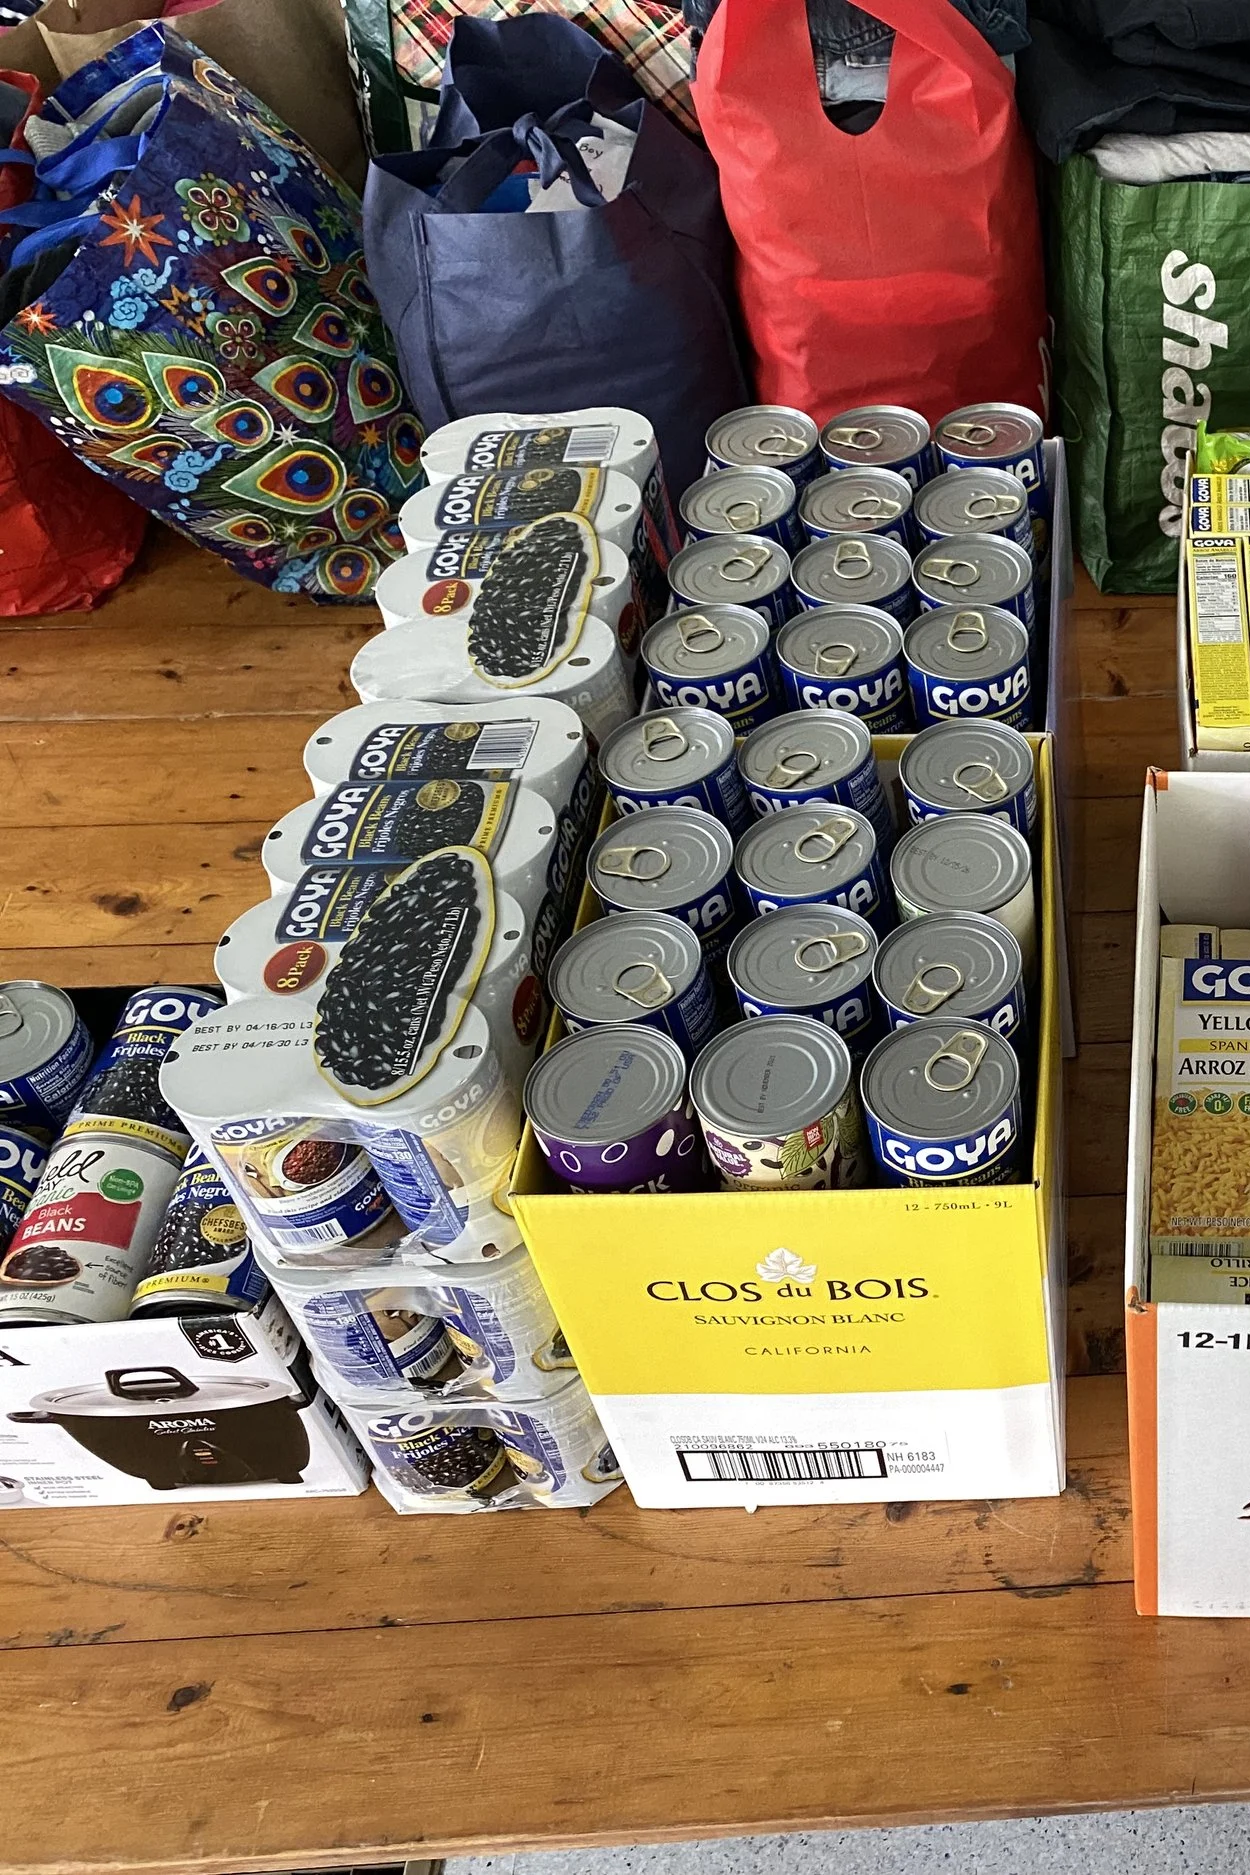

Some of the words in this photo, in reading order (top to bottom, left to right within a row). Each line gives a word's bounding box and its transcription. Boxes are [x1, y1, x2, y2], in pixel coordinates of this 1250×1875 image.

[579, 143, 603, 159] Boy
[443, 476, 484, 524] GOYA
[1194, 539, 1235, 547] GOYA
[433, 532, 469, 577] GOYA
[442, 582, 459, 605] Pack
[656, 671, 764, 708] GOYA
[802, 668, 902, 710] GOYA
[930, 665, 1030, 715] GOYA
[358, 727, 405, 779] GOYA
[312, 786, 370, 858] GOYA
[360, 820, 381, 848] Black
[373, 794, 392, 820] Beans
[372, 822, 395, 853] Frijoles
[286, 869, 340, 936] GOYA
[290, 946, 313, 977] Pack
[194, 1025, 220, 1034] BEST
[227, 1024, 240, 1032] BY
[245, 1022, 296, 1031] 04/16/30
[408, 1015, 422, 1036] cans
[126, 1032, 166, 1044] Black
[192, 1042, 219, 1052] BEST
[223, 1041, 239, 1050] BY
[111, 1044, 166, 1058] Frijoles
[1179, 1058, 1246, 1076] ARROZ
[78, 1120, 117, 1129] PRIME
[211, 1117, 288, 1141] GOYA
[884, 1118, 1015, 1171] GOYA
[38, 1205, 72, 1220] Black
[904, 1203, 921, 1212] 12
[934, 1201, 980, 1211] 750mL
[22, 1218, 86, 1240] BEANS
[646, 1280, 762, 1302] CLOS
[777, 1283, 813, 1298] du
[694, 1315, 829, 1325] SAUVIGNON
[832, 1313, 906, 1324] BLANC
[745, 1345, 872, 1356] CALIFORNIA
[148, 1418, 216, 1430] AROMA
[887, 1453, 904, 1462] NH
[907, 1452, 936, 1461] 6183
